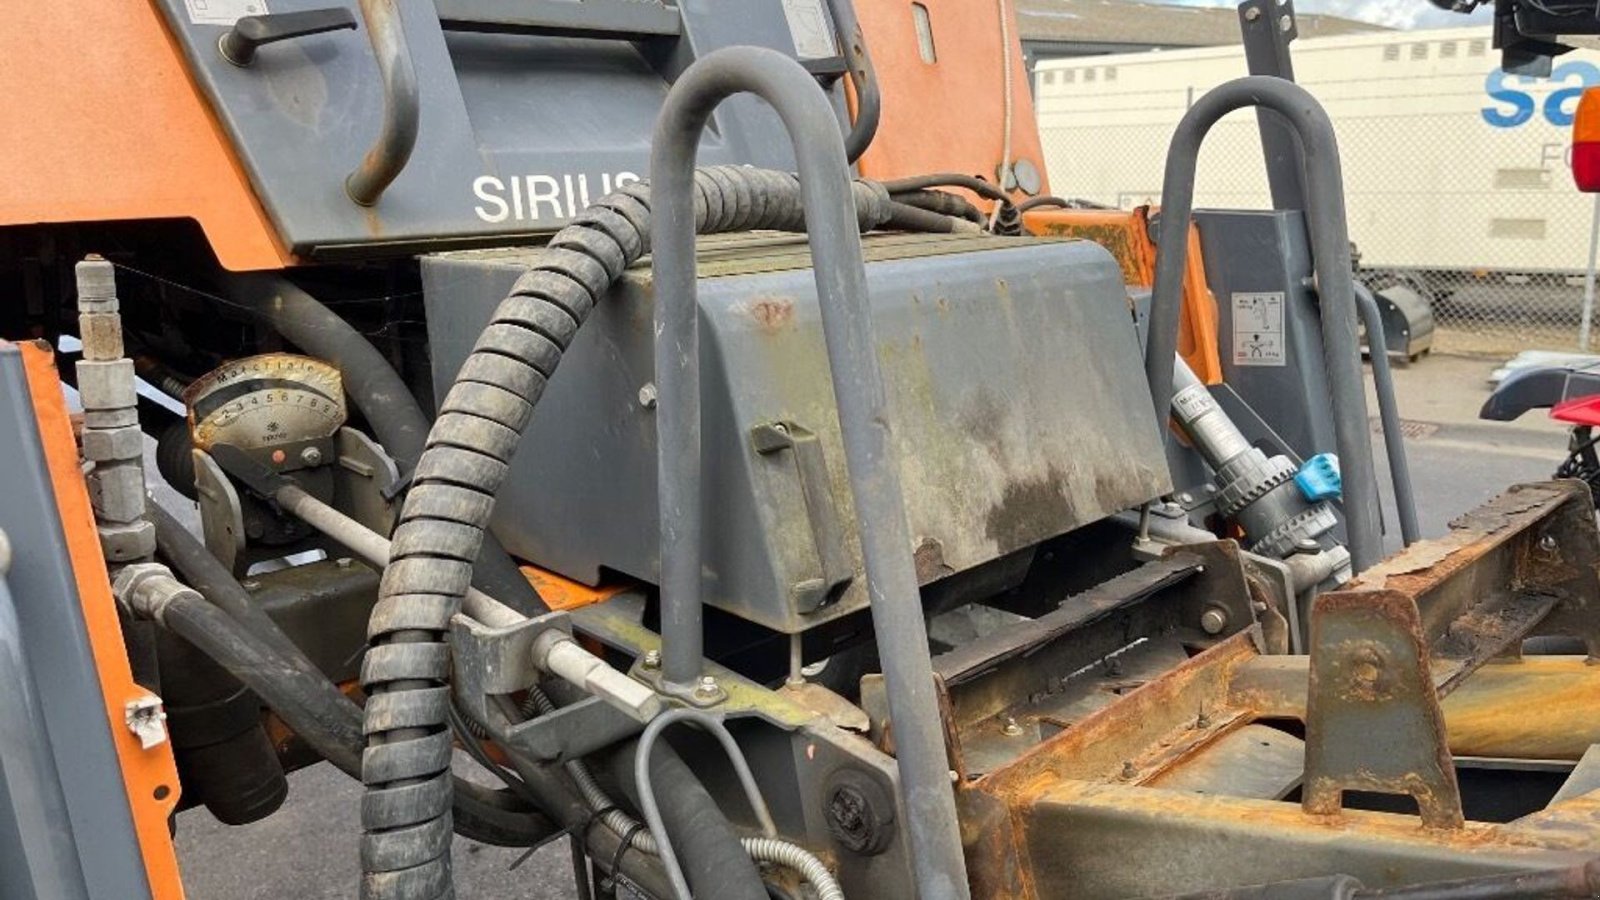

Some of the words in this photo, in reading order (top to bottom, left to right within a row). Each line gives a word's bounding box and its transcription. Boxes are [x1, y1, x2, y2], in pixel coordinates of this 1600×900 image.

[221, 409, 231, 419] 2
[236, 402, 244, 410] 3
[251, 397, 259, 405] 4
[266, 394, 273, 402] 5
[282, 393, 288, 402] 6
[310, 398, 316, 407] 8
